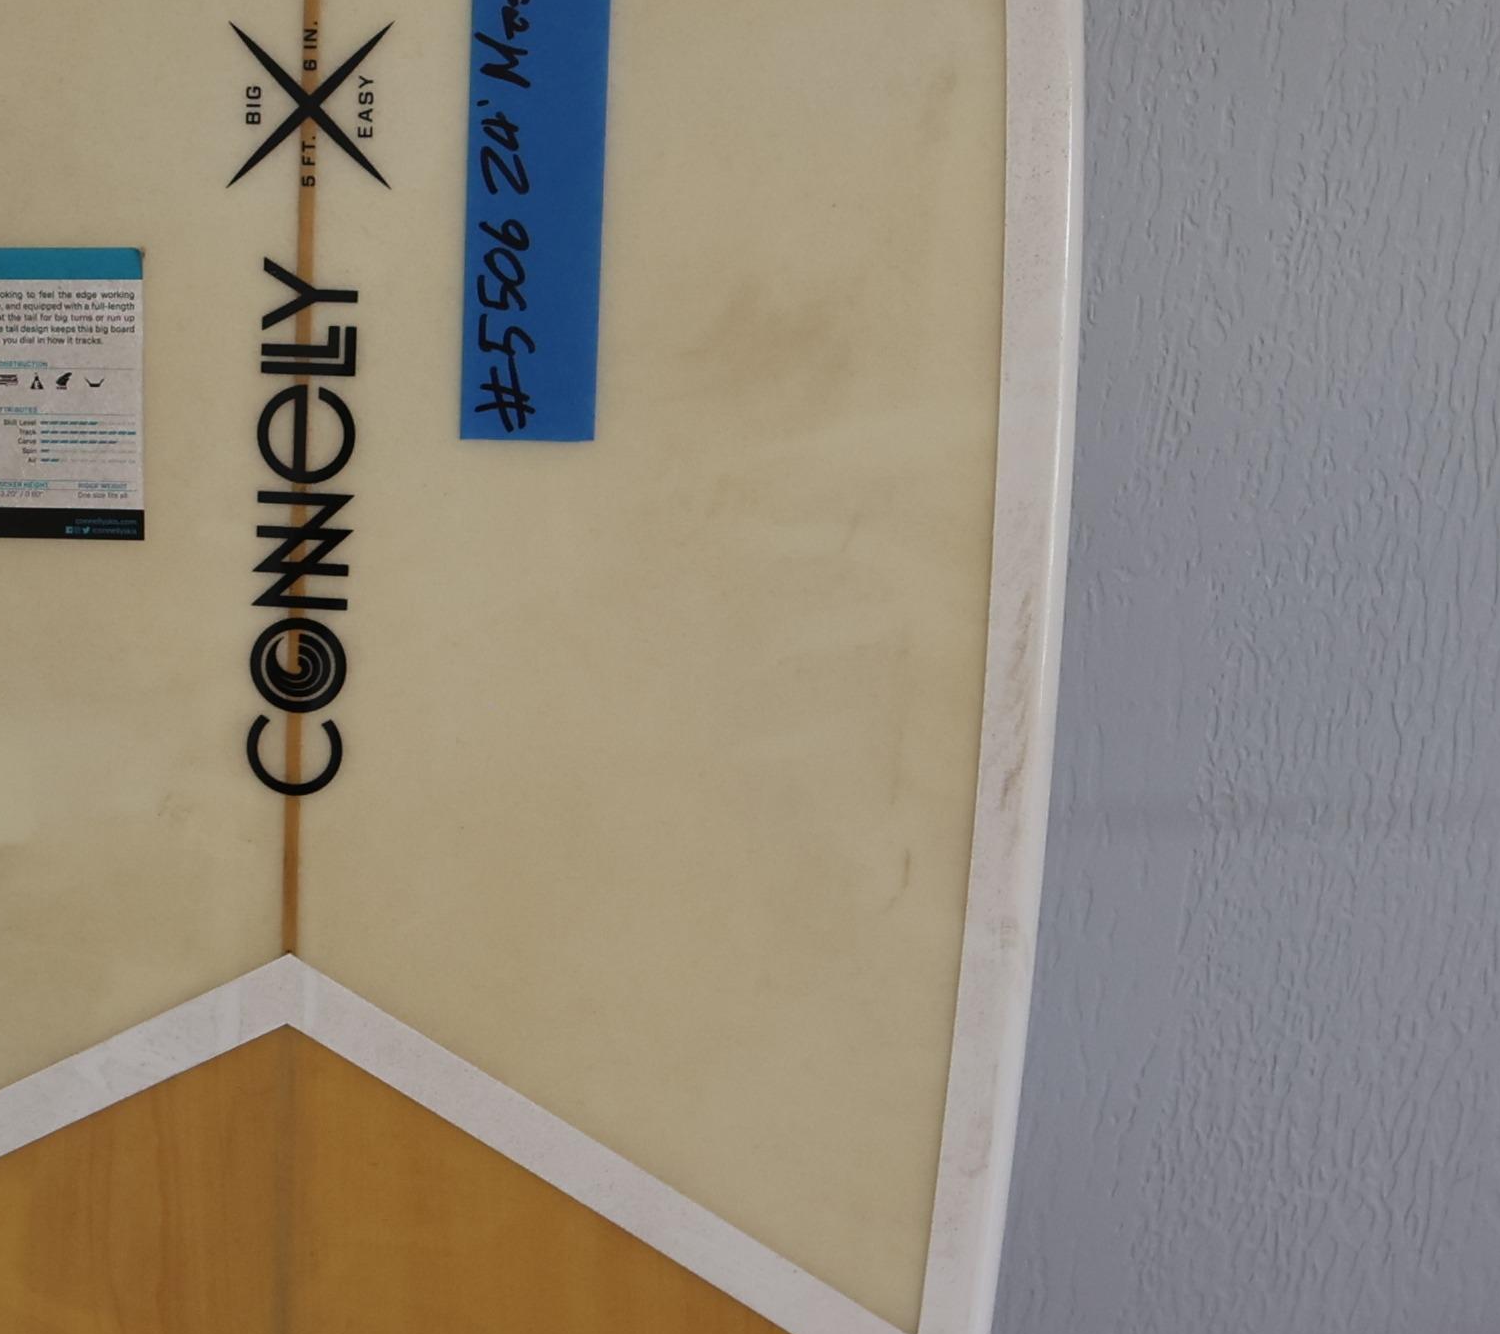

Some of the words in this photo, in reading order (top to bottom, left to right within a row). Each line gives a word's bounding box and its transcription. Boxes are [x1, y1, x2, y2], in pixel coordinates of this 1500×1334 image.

[303, 20, 318, 49] IN.
[246, 85, 261, 125] BIG
[358, 75, 374, 138] EASY
[301, 135, 316, 166] FT.
[301, 175, 315, 187] 5
[474, 218, 536, 433] #5506
